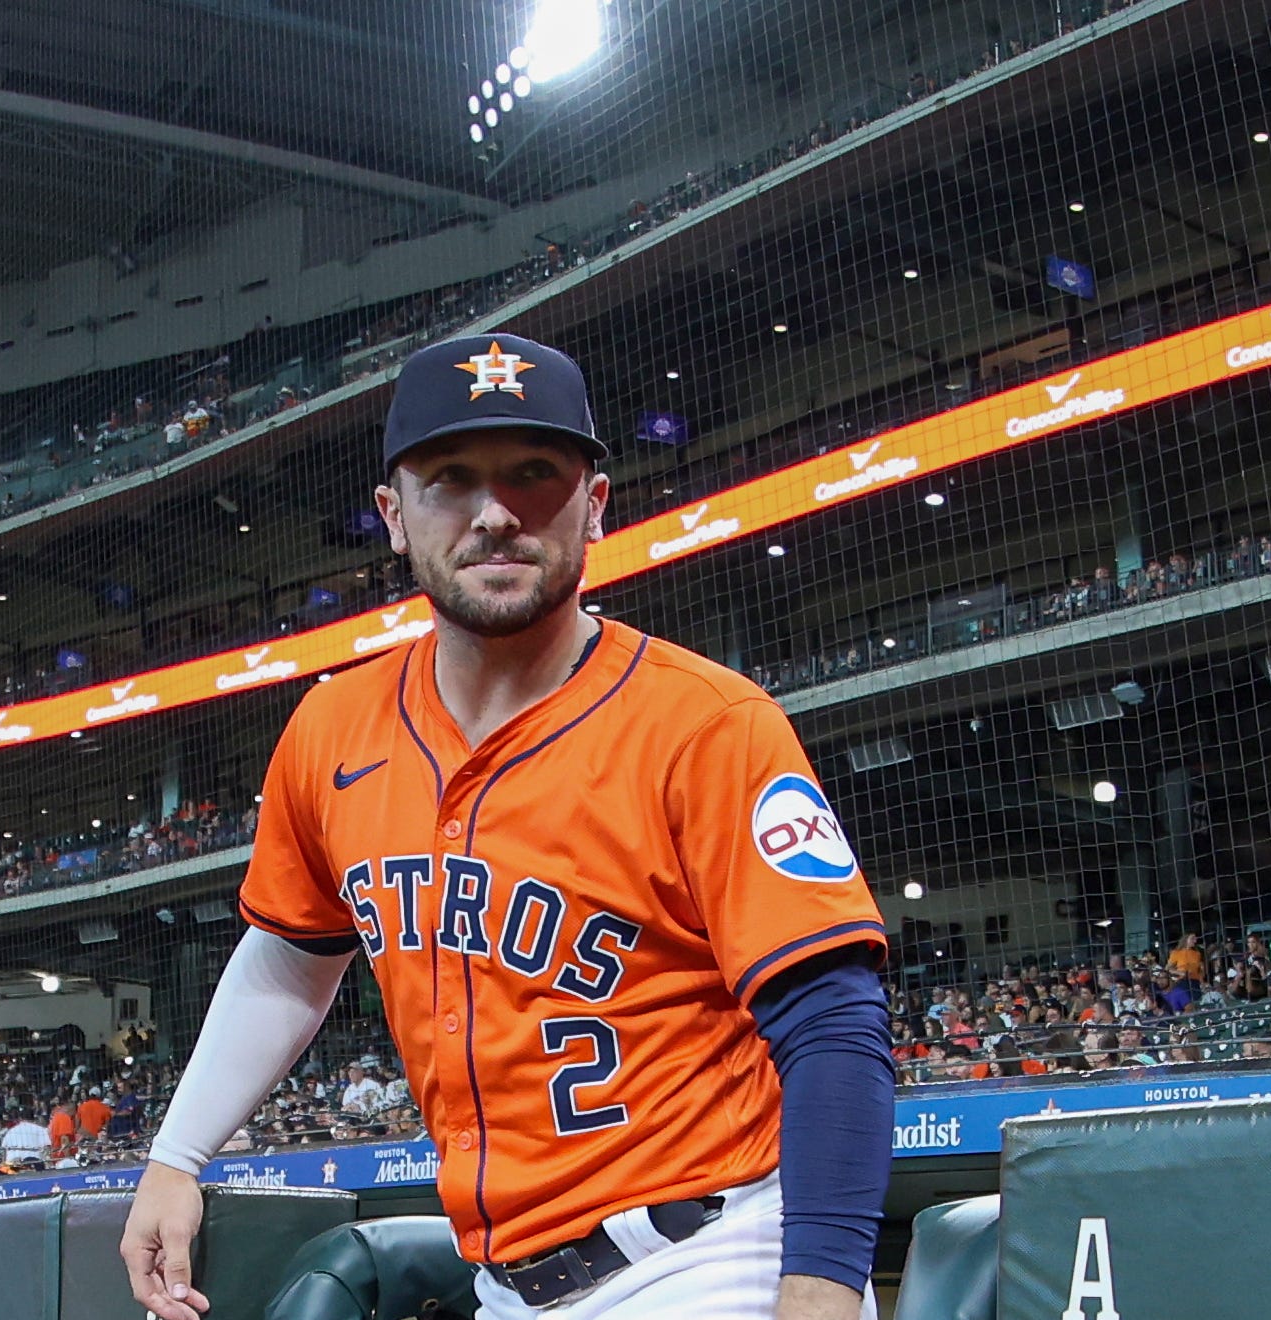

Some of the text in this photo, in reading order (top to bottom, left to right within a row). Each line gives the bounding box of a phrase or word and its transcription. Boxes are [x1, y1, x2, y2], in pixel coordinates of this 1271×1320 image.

[469, 354, 524, 392] H
[1006, 388, 1125, 438] ConocoPhillips
[759, 815, 842, 857] OXY
[339, 853, 643, 1003] STROS
[541, 1016, 630, 1137] 2
[1144, 1086, 1209, 1102] HOUSTON
[223, 1163, 250, 1172] HOUSTON
[374, 1148, 406, 1159] HOUSTON
[374, 1152, 439, 1183] Methodi
[227, 1164, 287, 1186] Methodist
